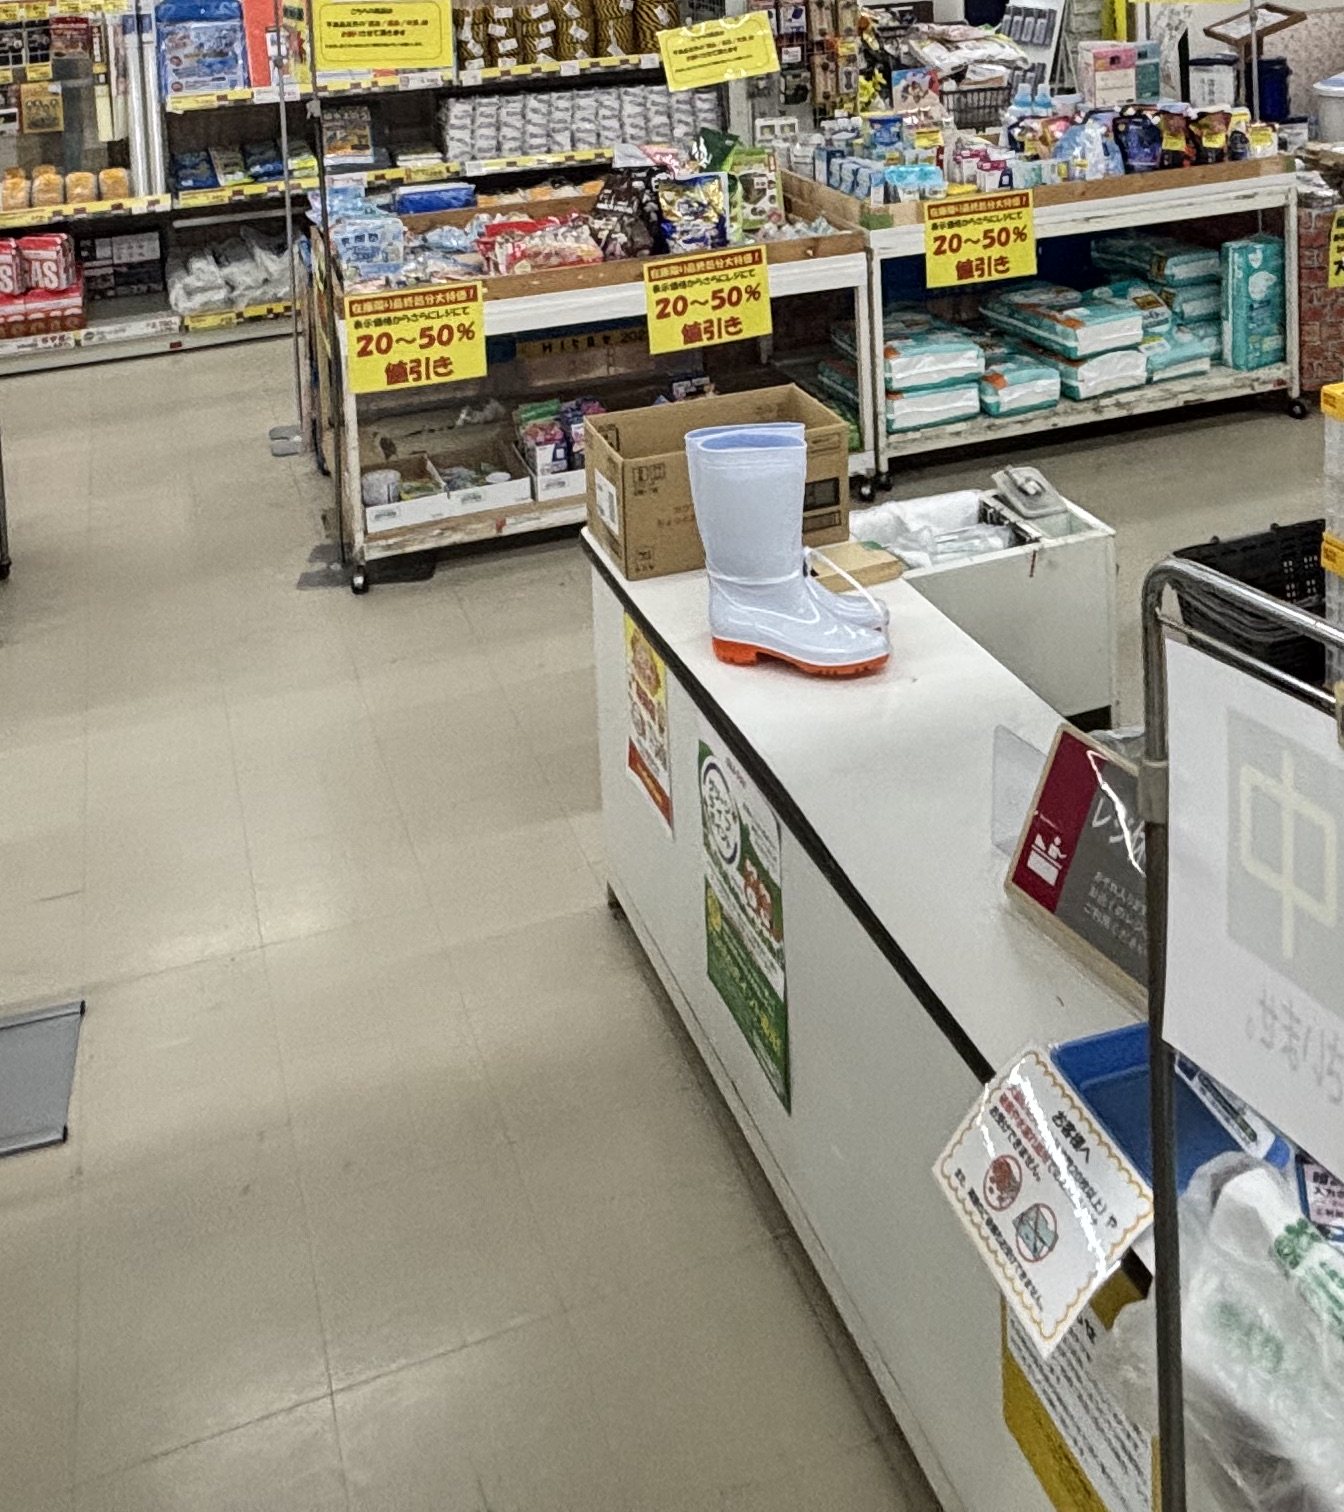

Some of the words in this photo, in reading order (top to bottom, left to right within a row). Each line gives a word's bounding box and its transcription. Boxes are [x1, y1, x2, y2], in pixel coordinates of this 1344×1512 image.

[25, 260, 58, 292] AS
[955, 255, 1011, 281] 値引き
[681, 315, 744, 346] 値引き
[384, 355, 455, 386] 値引き
[1052, 1110, 1091, 1165] お客様へ
